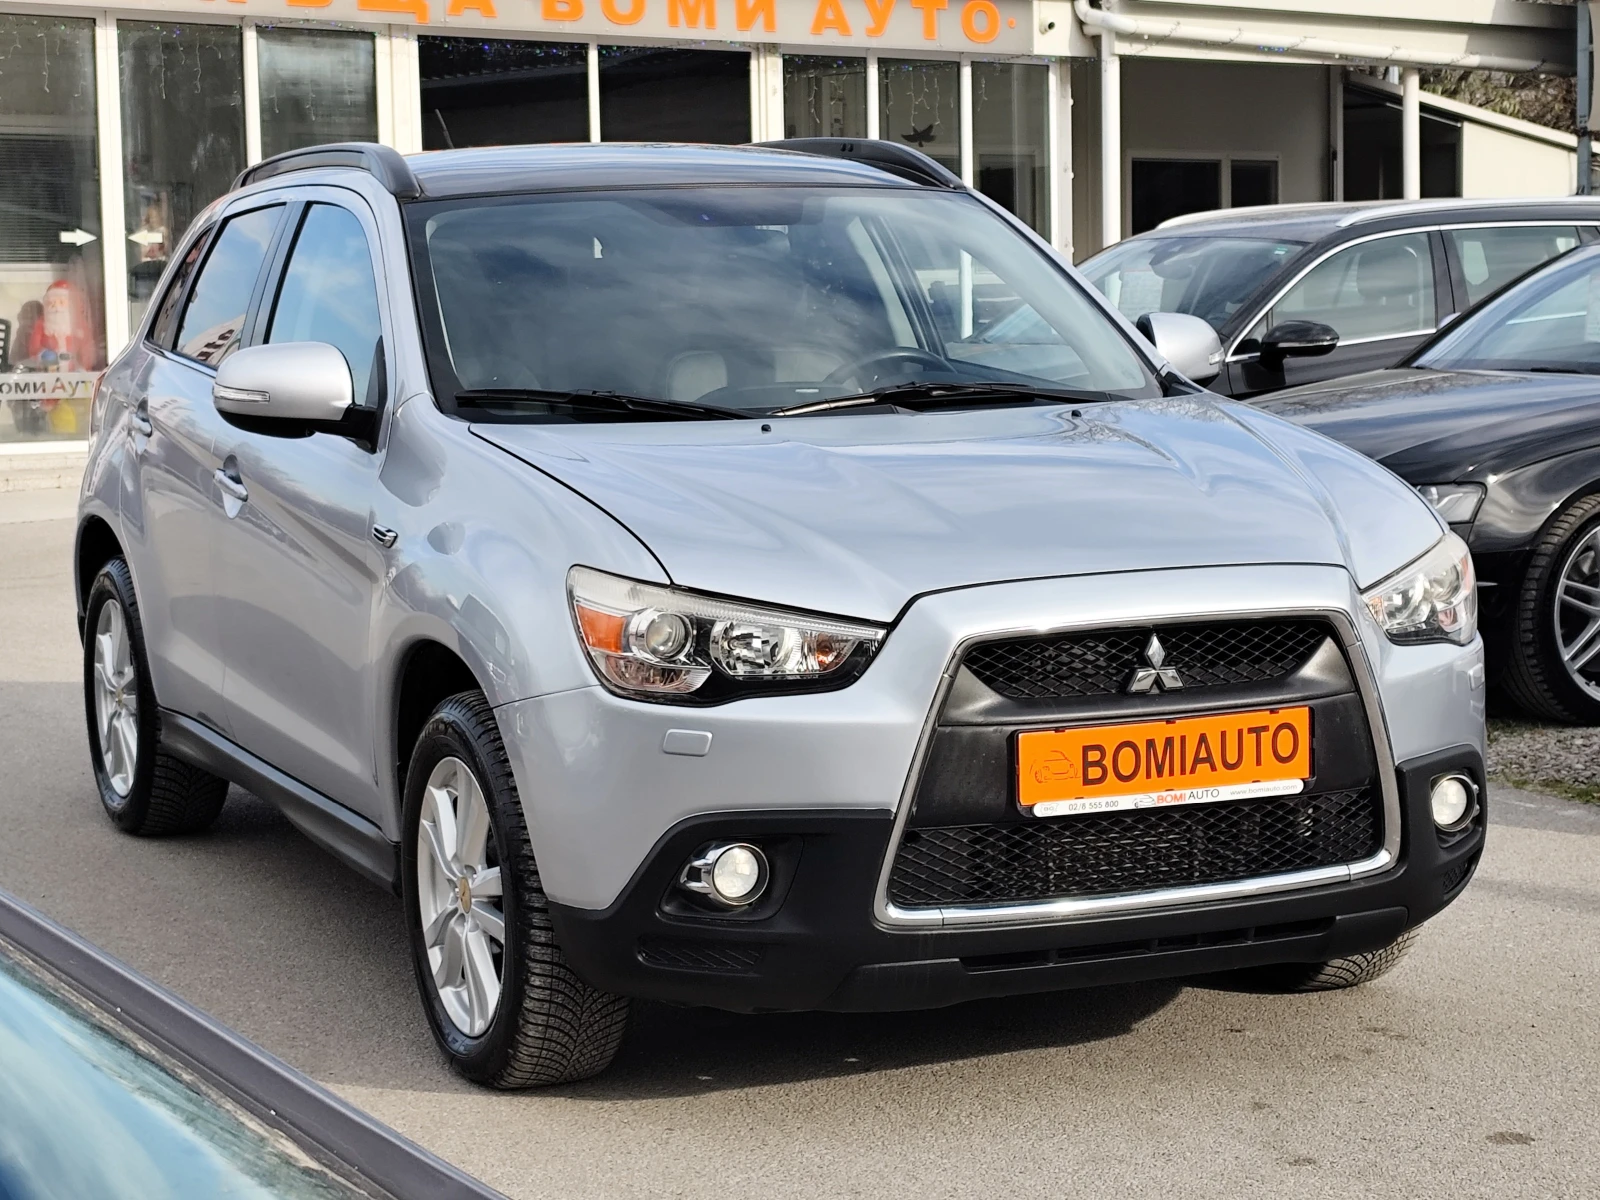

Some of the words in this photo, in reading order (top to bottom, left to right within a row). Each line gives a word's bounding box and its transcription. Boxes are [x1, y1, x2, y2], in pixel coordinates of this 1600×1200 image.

[810, 0, 1000, 43] АУТО
[51, 377, 94, 397] Аут
[1082, 722, 1299, 786] BOMIAUTO
[1068, 802, 1086, 812] 02/8
[1089, 801, 1103, 810] 555
[1105, 800, 1119, 809] 800
[1156, 793, 1187, 804] BOMI
[1188, 789, 1220, 801] AUTO
[1230, 784, 1298, 796] www.bomiauto.com
